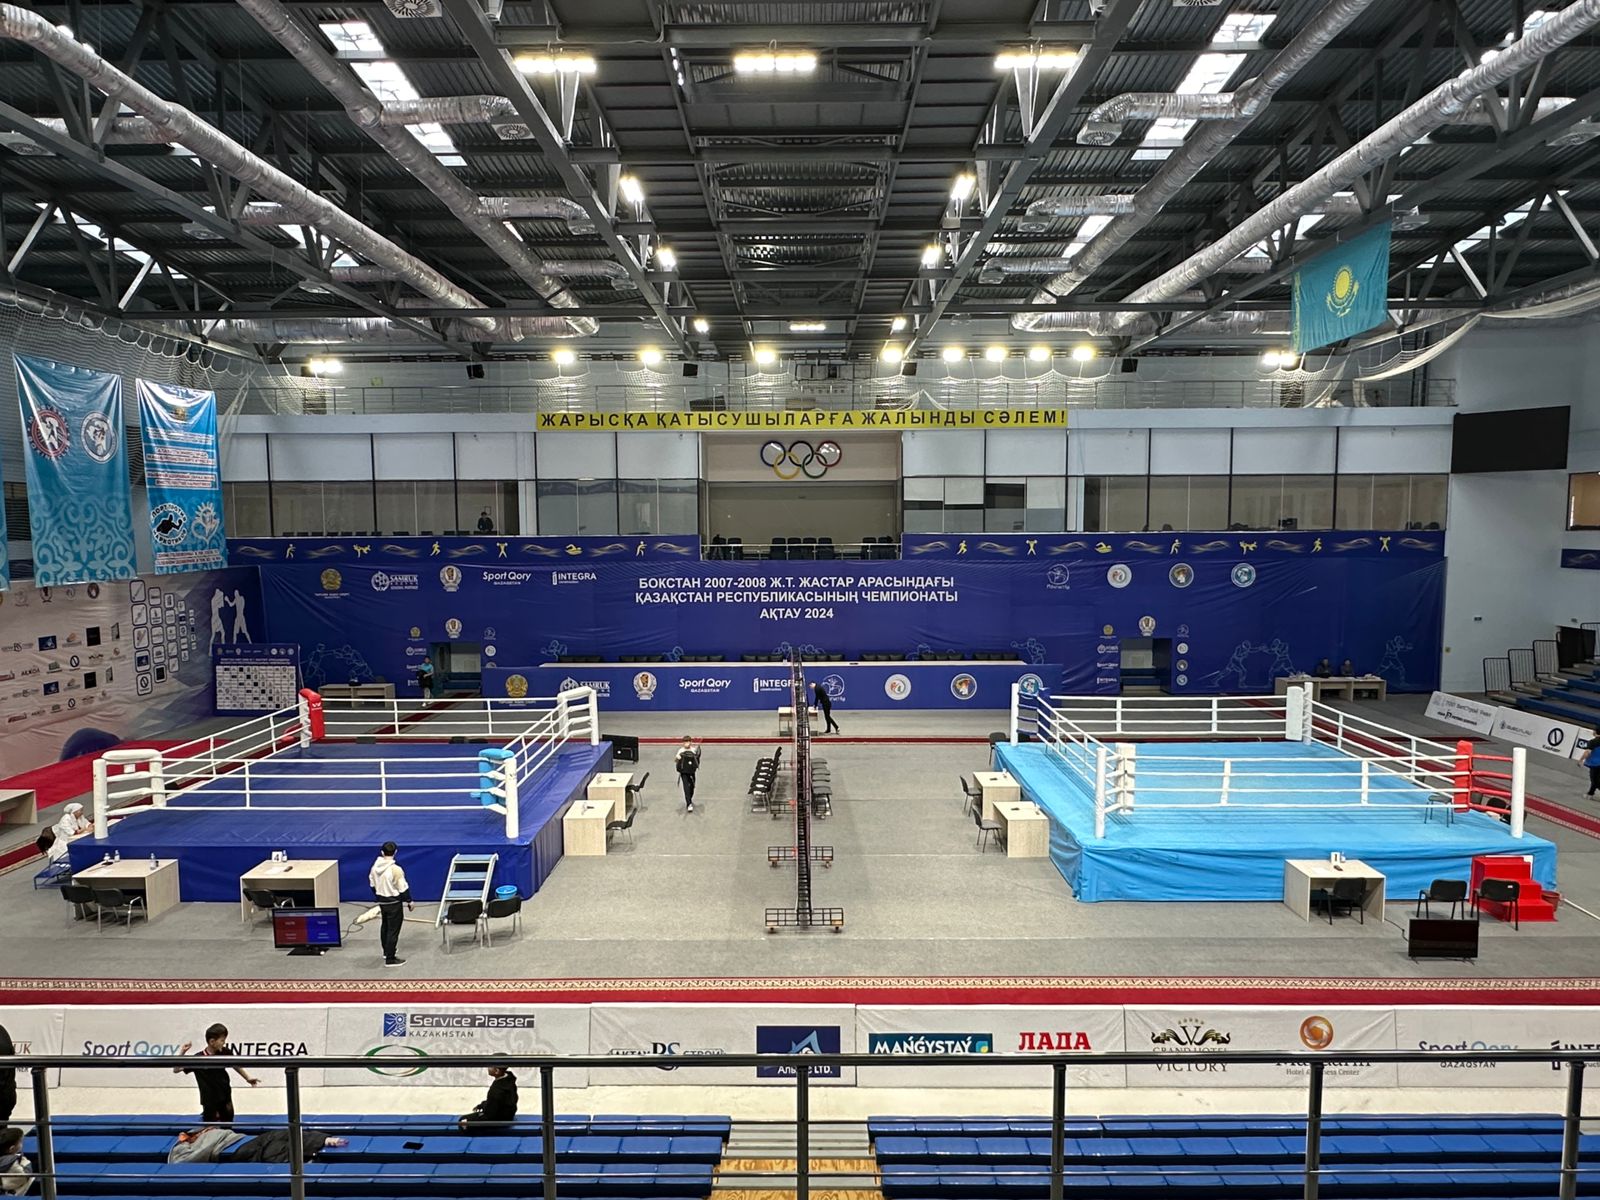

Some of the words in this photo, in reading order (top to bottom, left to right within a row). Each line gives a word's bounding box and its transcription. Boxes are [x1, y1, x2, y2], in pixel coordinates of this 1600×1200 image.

[541, 412, 649, 429] ЖАРЫСҚА
[656, 411, 854, 429] ҚАТЫСУШЫЛАРҒА
[861, 410, 975, 427] ЖАЛЫНДЫ
[983, 410, 1066, 424] СӘЛЕМ!
[483, 571, 507, 581] Sport
[508, 571, 531, 581] Qory
[558, 572, 597, 580] INTEGRA
[639, 577, 701, 589] БОКСТАН
[704, 577, 767, 588] 2007-2008
[770, 577, 796, 588] Ж.Т.
[798, 577, 855, 588] ЖАСТАР
[857, 576, 954, 589] АРАСЫНДАҒЫ
[635, 592, 713, 605] ҚАЗАҚСТАН
[716, 591, 859, 604] РЕСПУБЛИКАСЫНЫҢ
[862, 590, 958, 602] ЧЕМПИОНАТЫ
[759, 608, 802, 620] АҚТАУ
[804, 607, 834, 619] 2024
[679, 678, 705, 689] Sport
[706, 678, 732, 689] Qory
[759, 679, 792, 687] INTEG
[274, 853, 280, 862] 4
[411, 1015, 471, 1027] Service
[475, 1015, 535, 1027] Plasser
[1018, 1032, 1092, 1050] ЛАДА
[82, 1040, 131, 1056] Sport
[1286, 1068, 1304, 1076] Hotel
